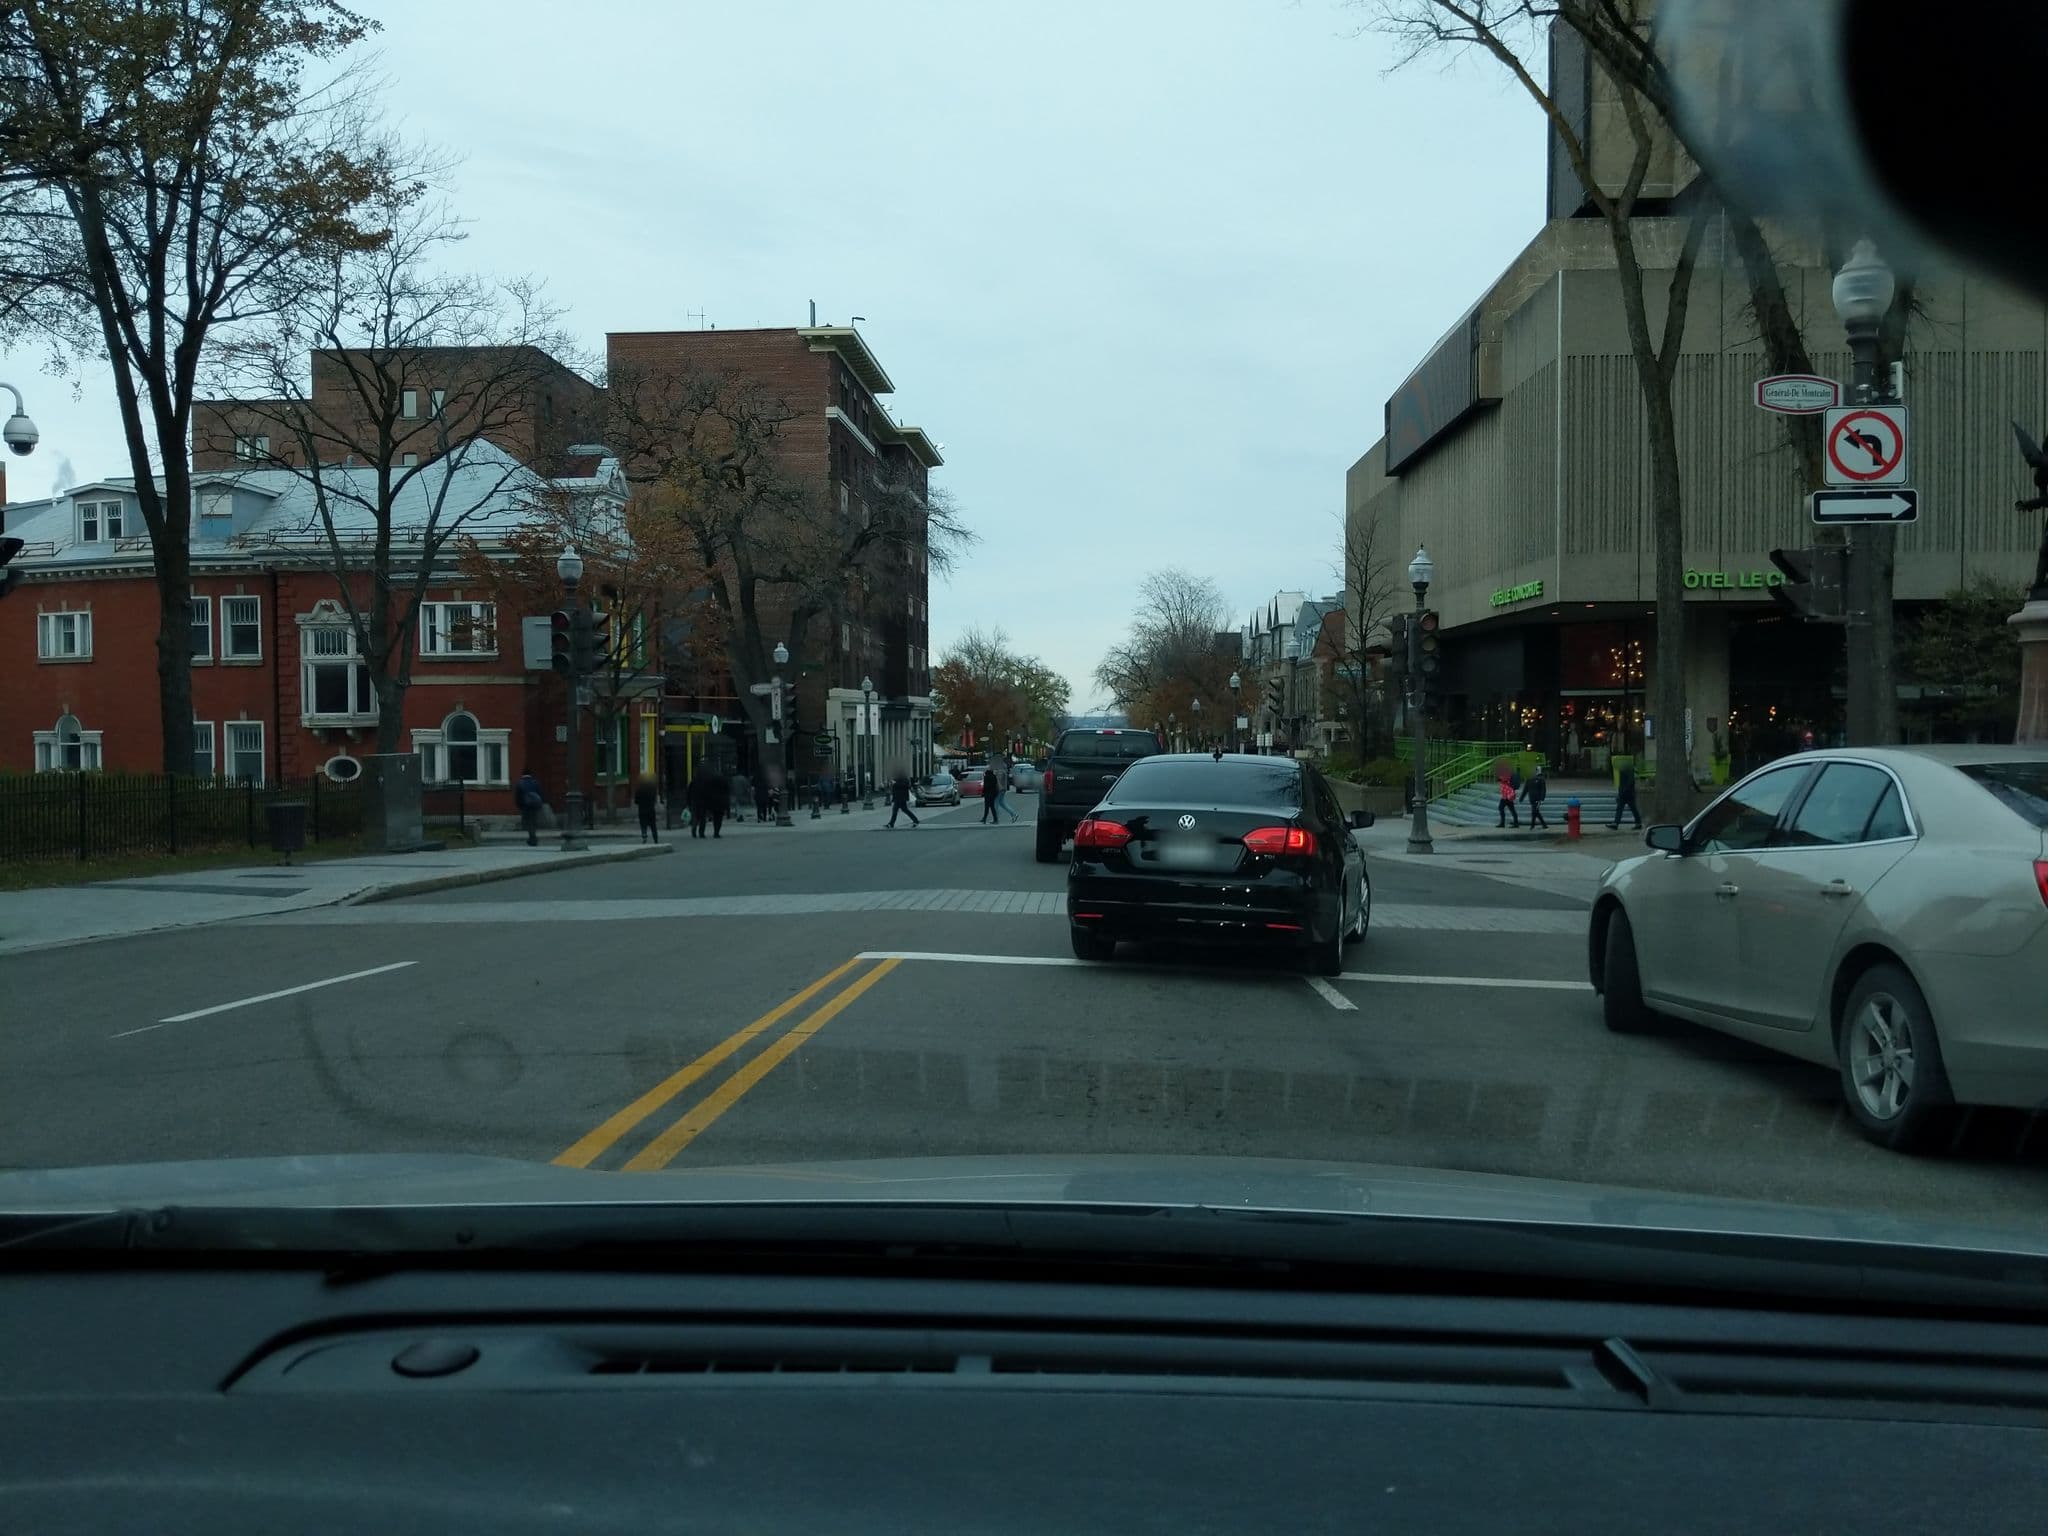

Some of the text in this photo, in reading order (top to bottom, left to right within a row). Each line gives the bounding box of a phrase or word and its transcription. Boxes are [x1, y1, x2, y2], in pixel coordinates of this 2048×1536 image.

[1802, 387, 1831, 397] Montcalm
[1683, 567, 1736, 588] ÔTEL
[1738, 569, 1764, 588] LE
